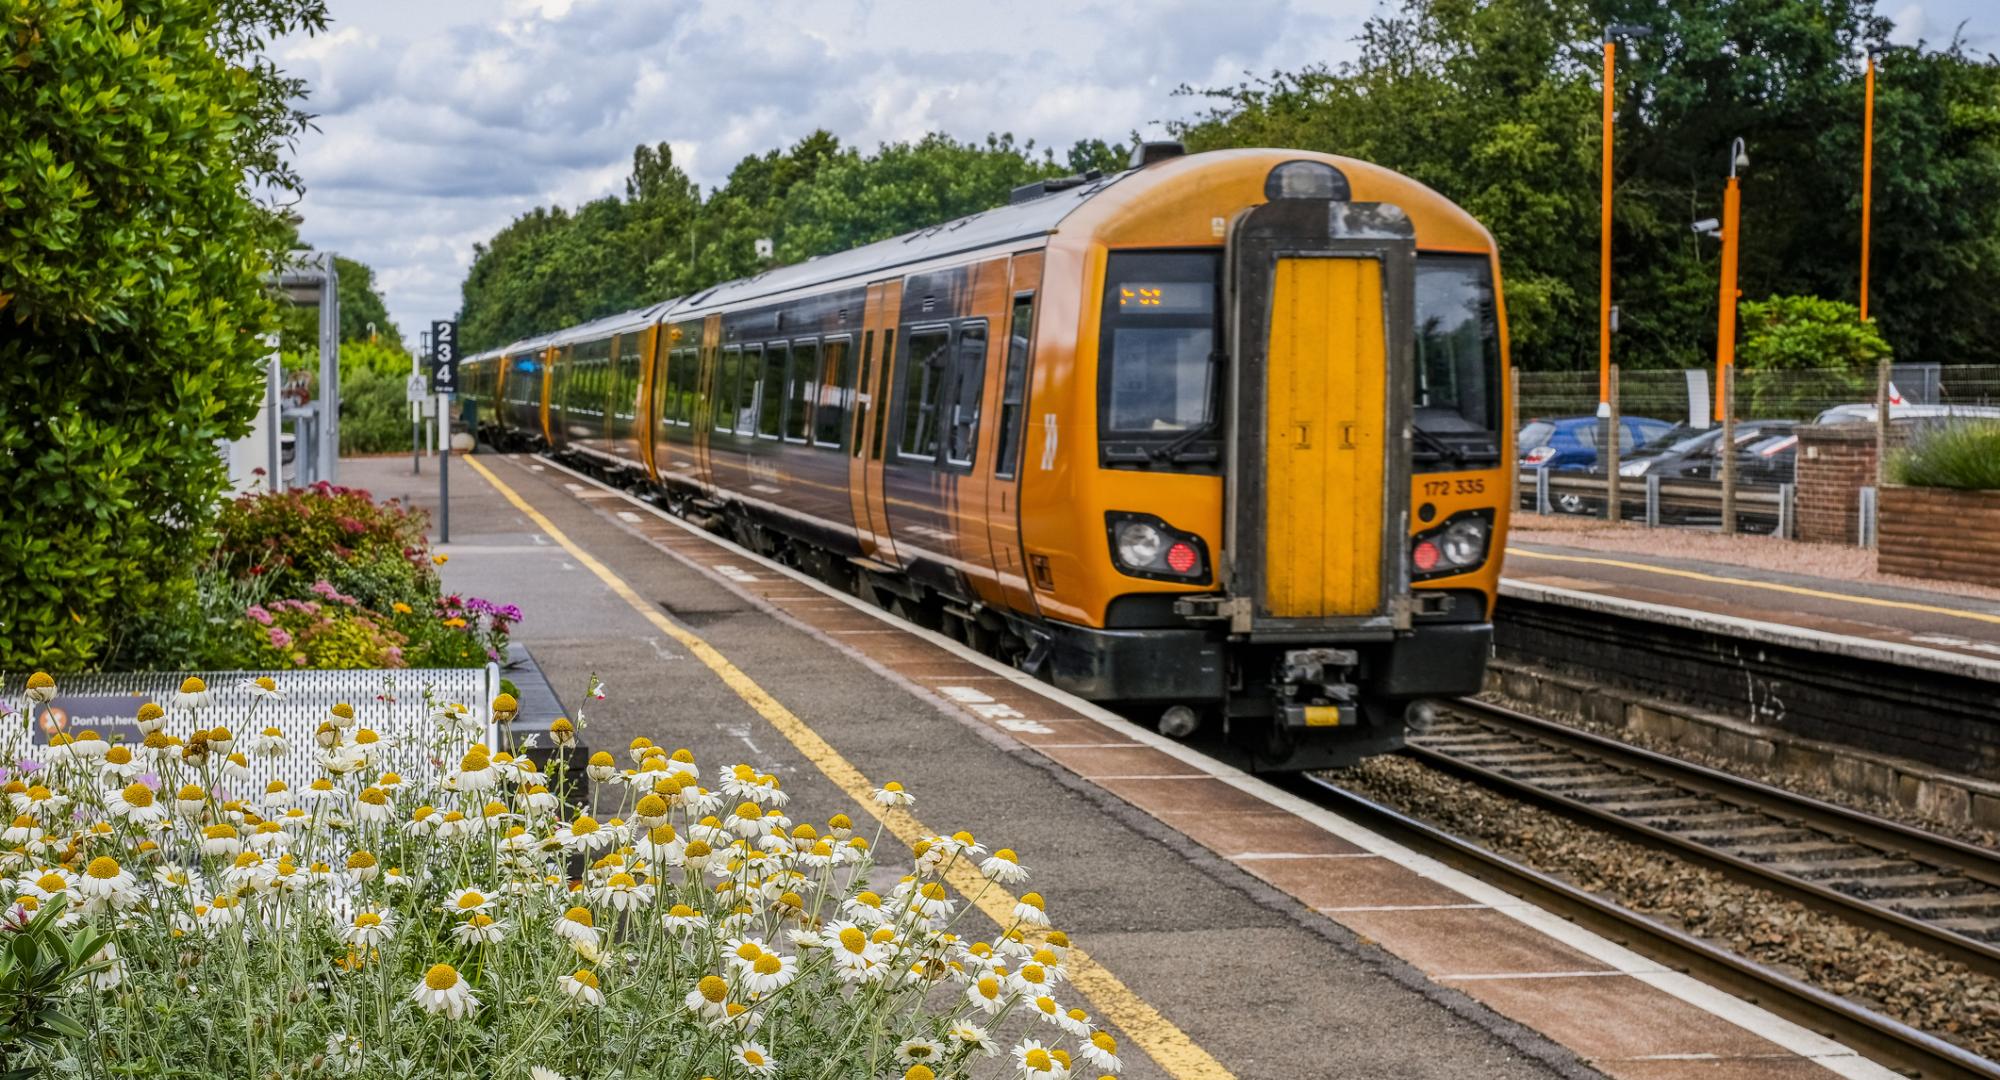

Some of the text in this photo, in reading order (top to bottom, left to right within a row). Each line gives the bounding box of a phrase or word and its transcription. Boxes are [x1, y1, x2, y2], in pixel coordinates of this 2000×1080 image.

[438, 322, 452, 341] 2
[437, 343, 452, 362] 3
[436, 364, 452, 383] 4
[1424, 479, 1485, 496] 172 335
[71, 716, 99, 726] Don't
[100, 715, 114, 726] sit
